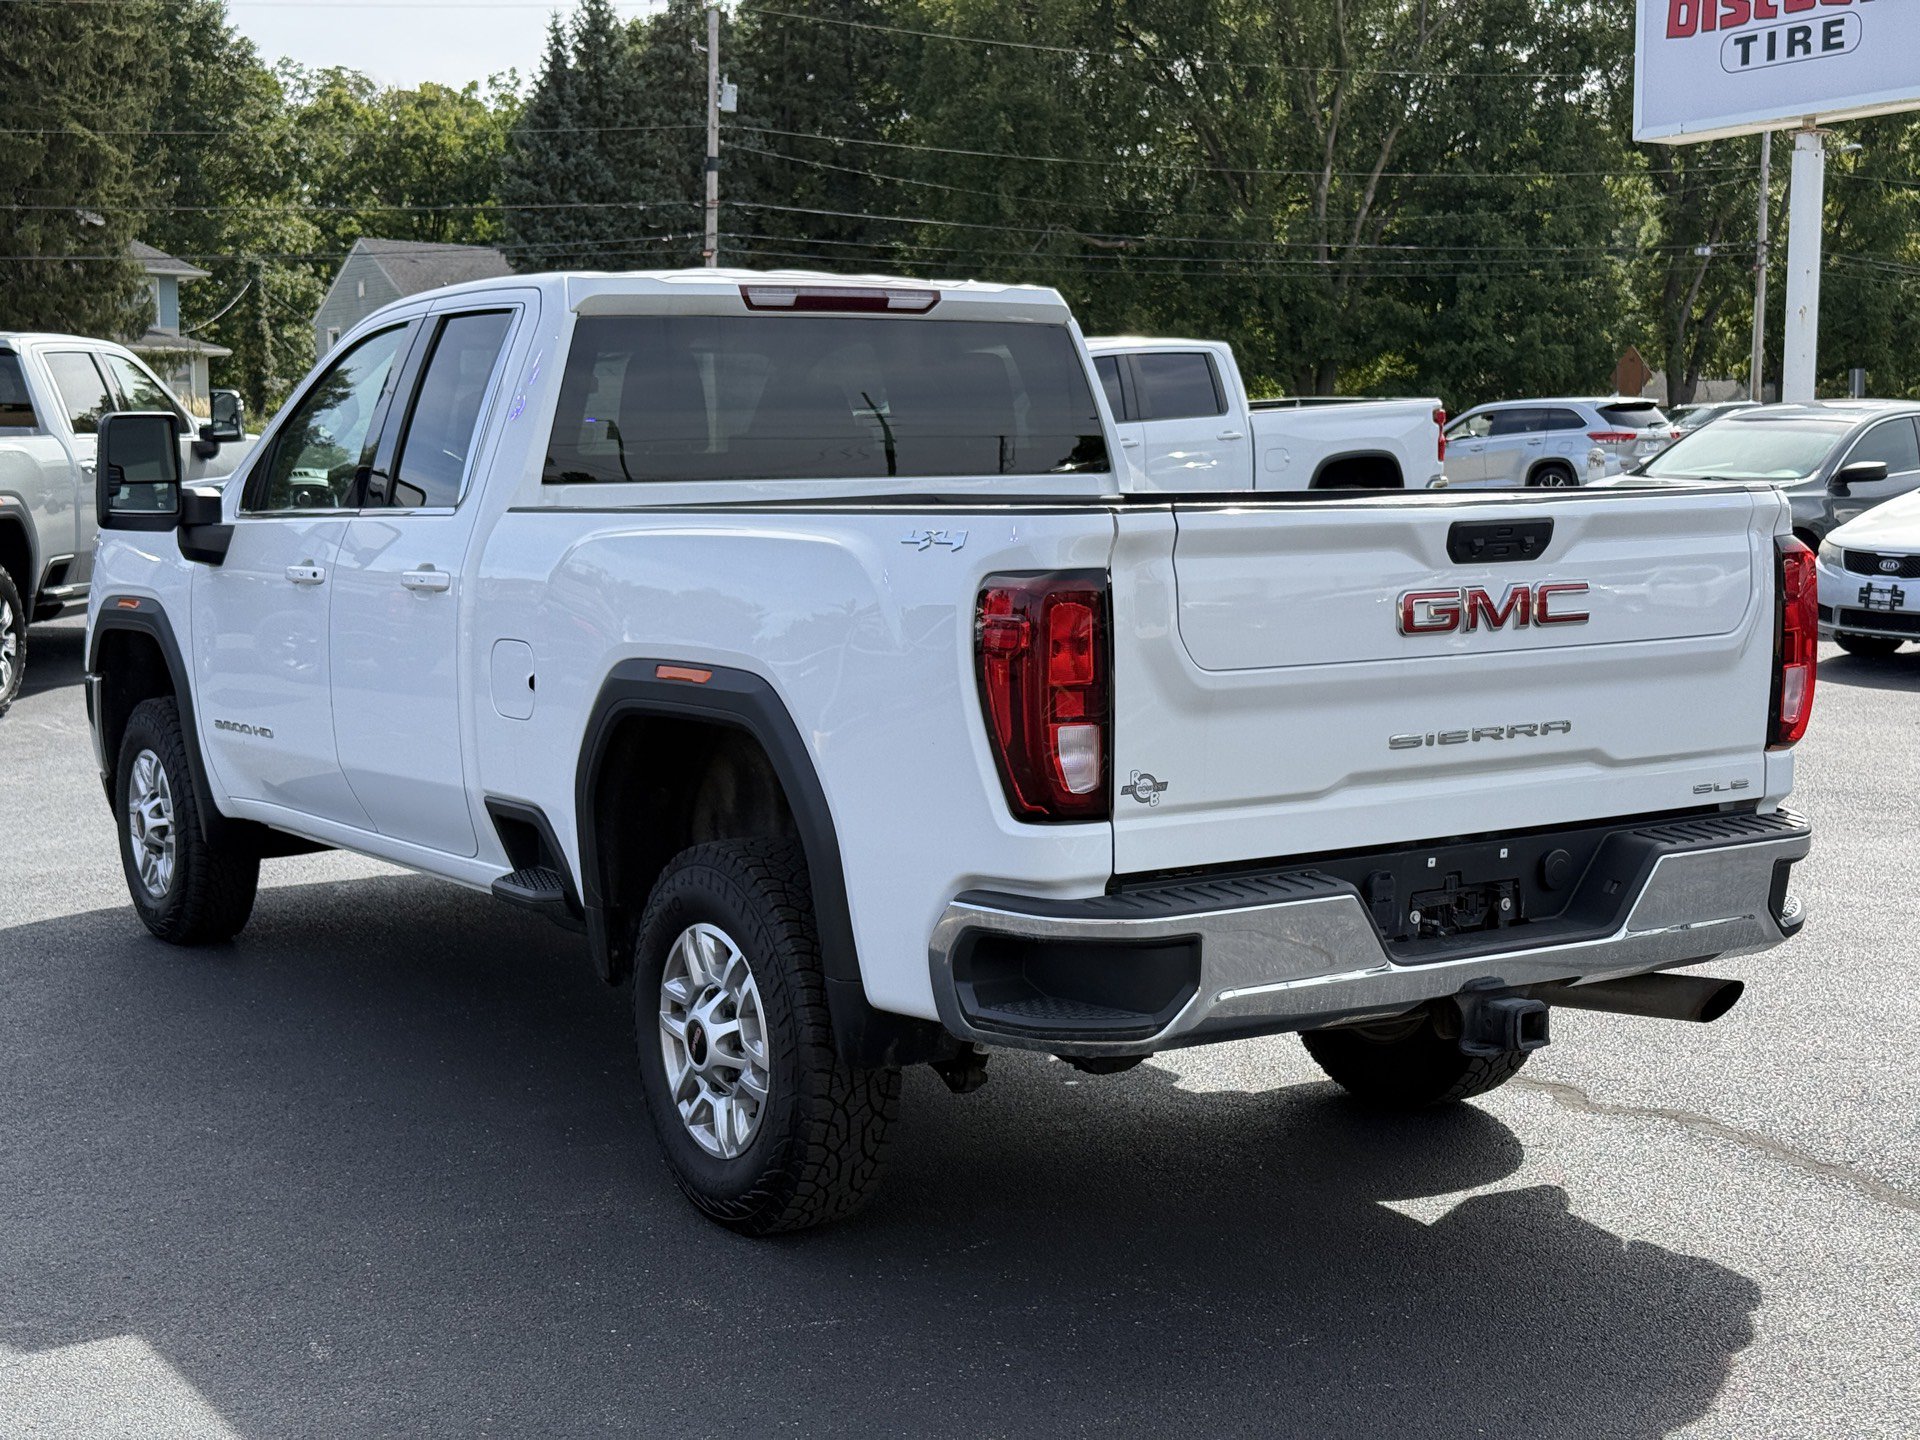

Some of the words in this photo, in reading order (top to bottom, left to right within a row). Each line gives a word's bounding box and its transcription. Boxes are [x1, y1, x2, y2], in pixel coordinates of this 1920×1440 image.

[1734, 18, 1845, 66] TIRE
[1396, 579, 1590, 638] GMC
[1388, 719, 1572, 750] SIERRA
[1692, 779, 1749, 794] SLE
